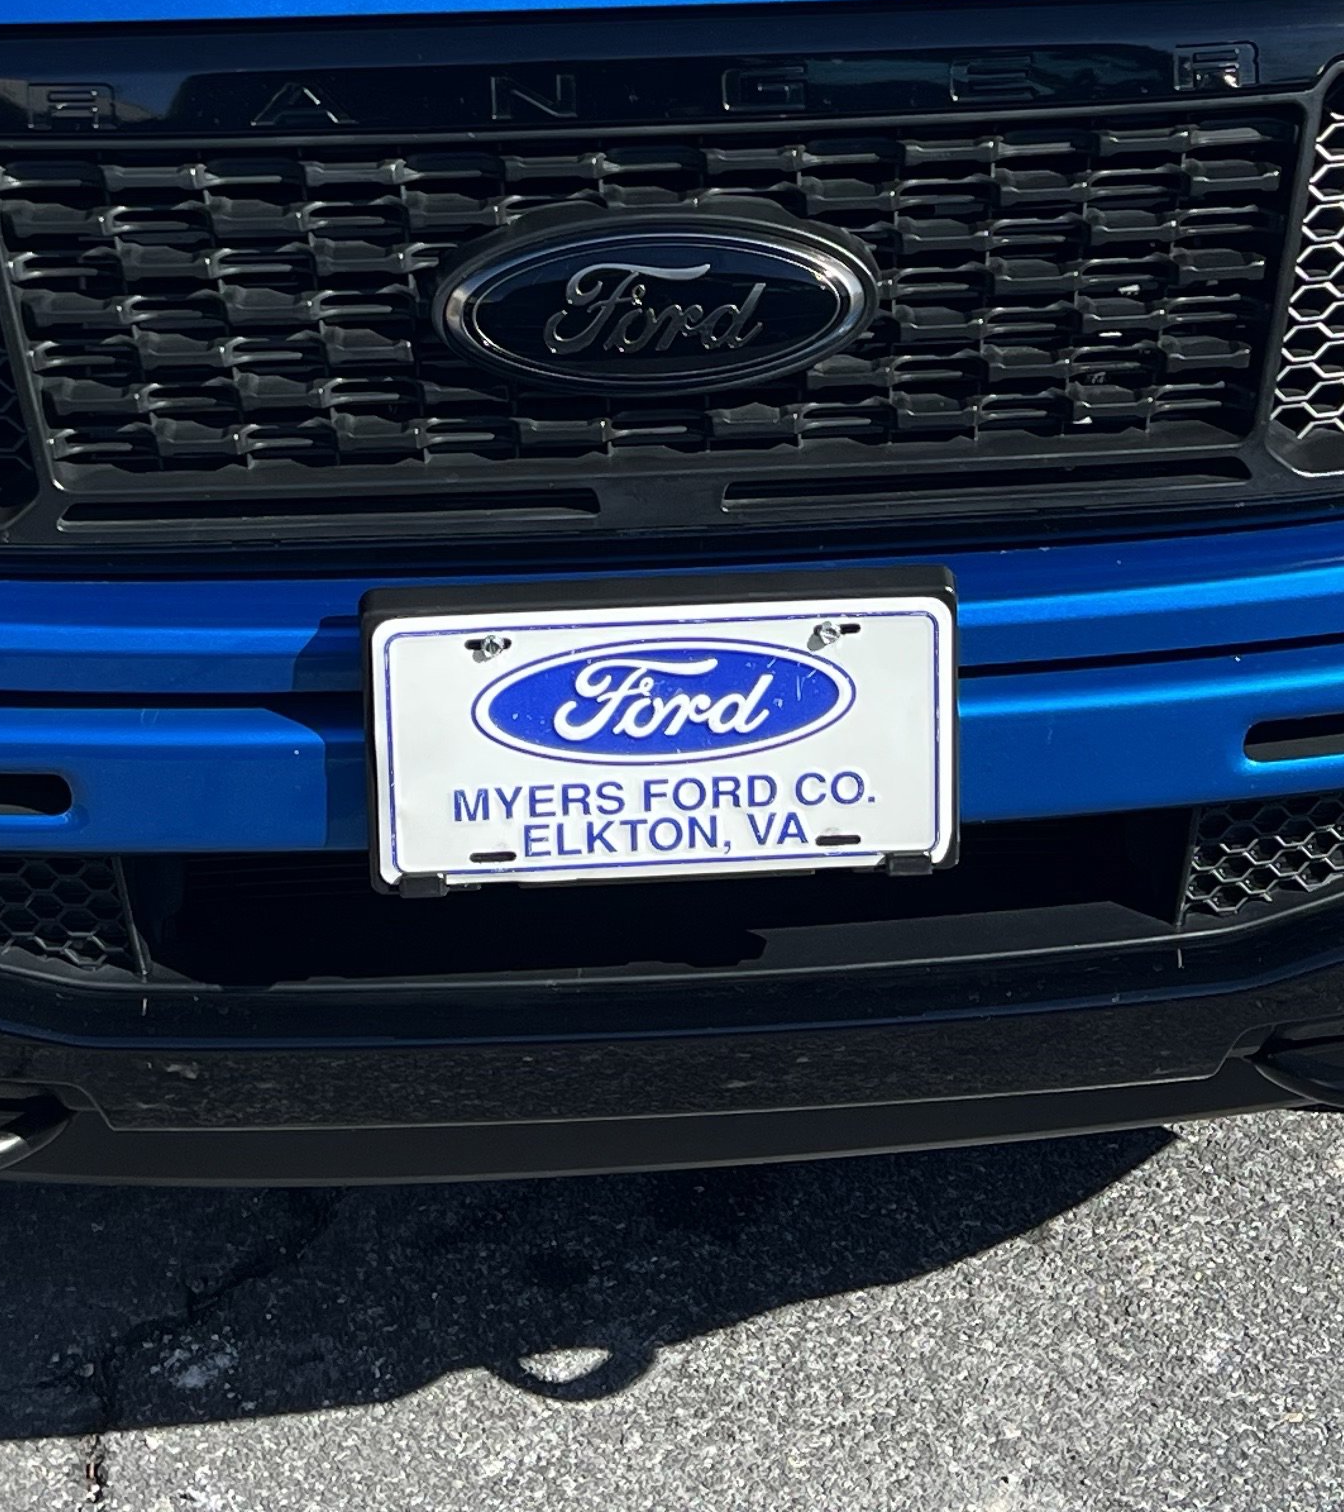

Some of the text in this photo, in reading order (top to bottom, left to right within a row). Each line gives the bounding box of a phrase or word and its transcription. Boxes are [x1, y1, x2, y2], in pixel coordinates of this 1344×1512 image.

[27, 40, 1259, 128] RANGER
[543, 263, 766, 355] Ford
[553, 657, 774, 741] Ford
[453, 771, 876, 822] MYERS FORD CO.
[524, 813, 808, 855] ELKTON, VA
